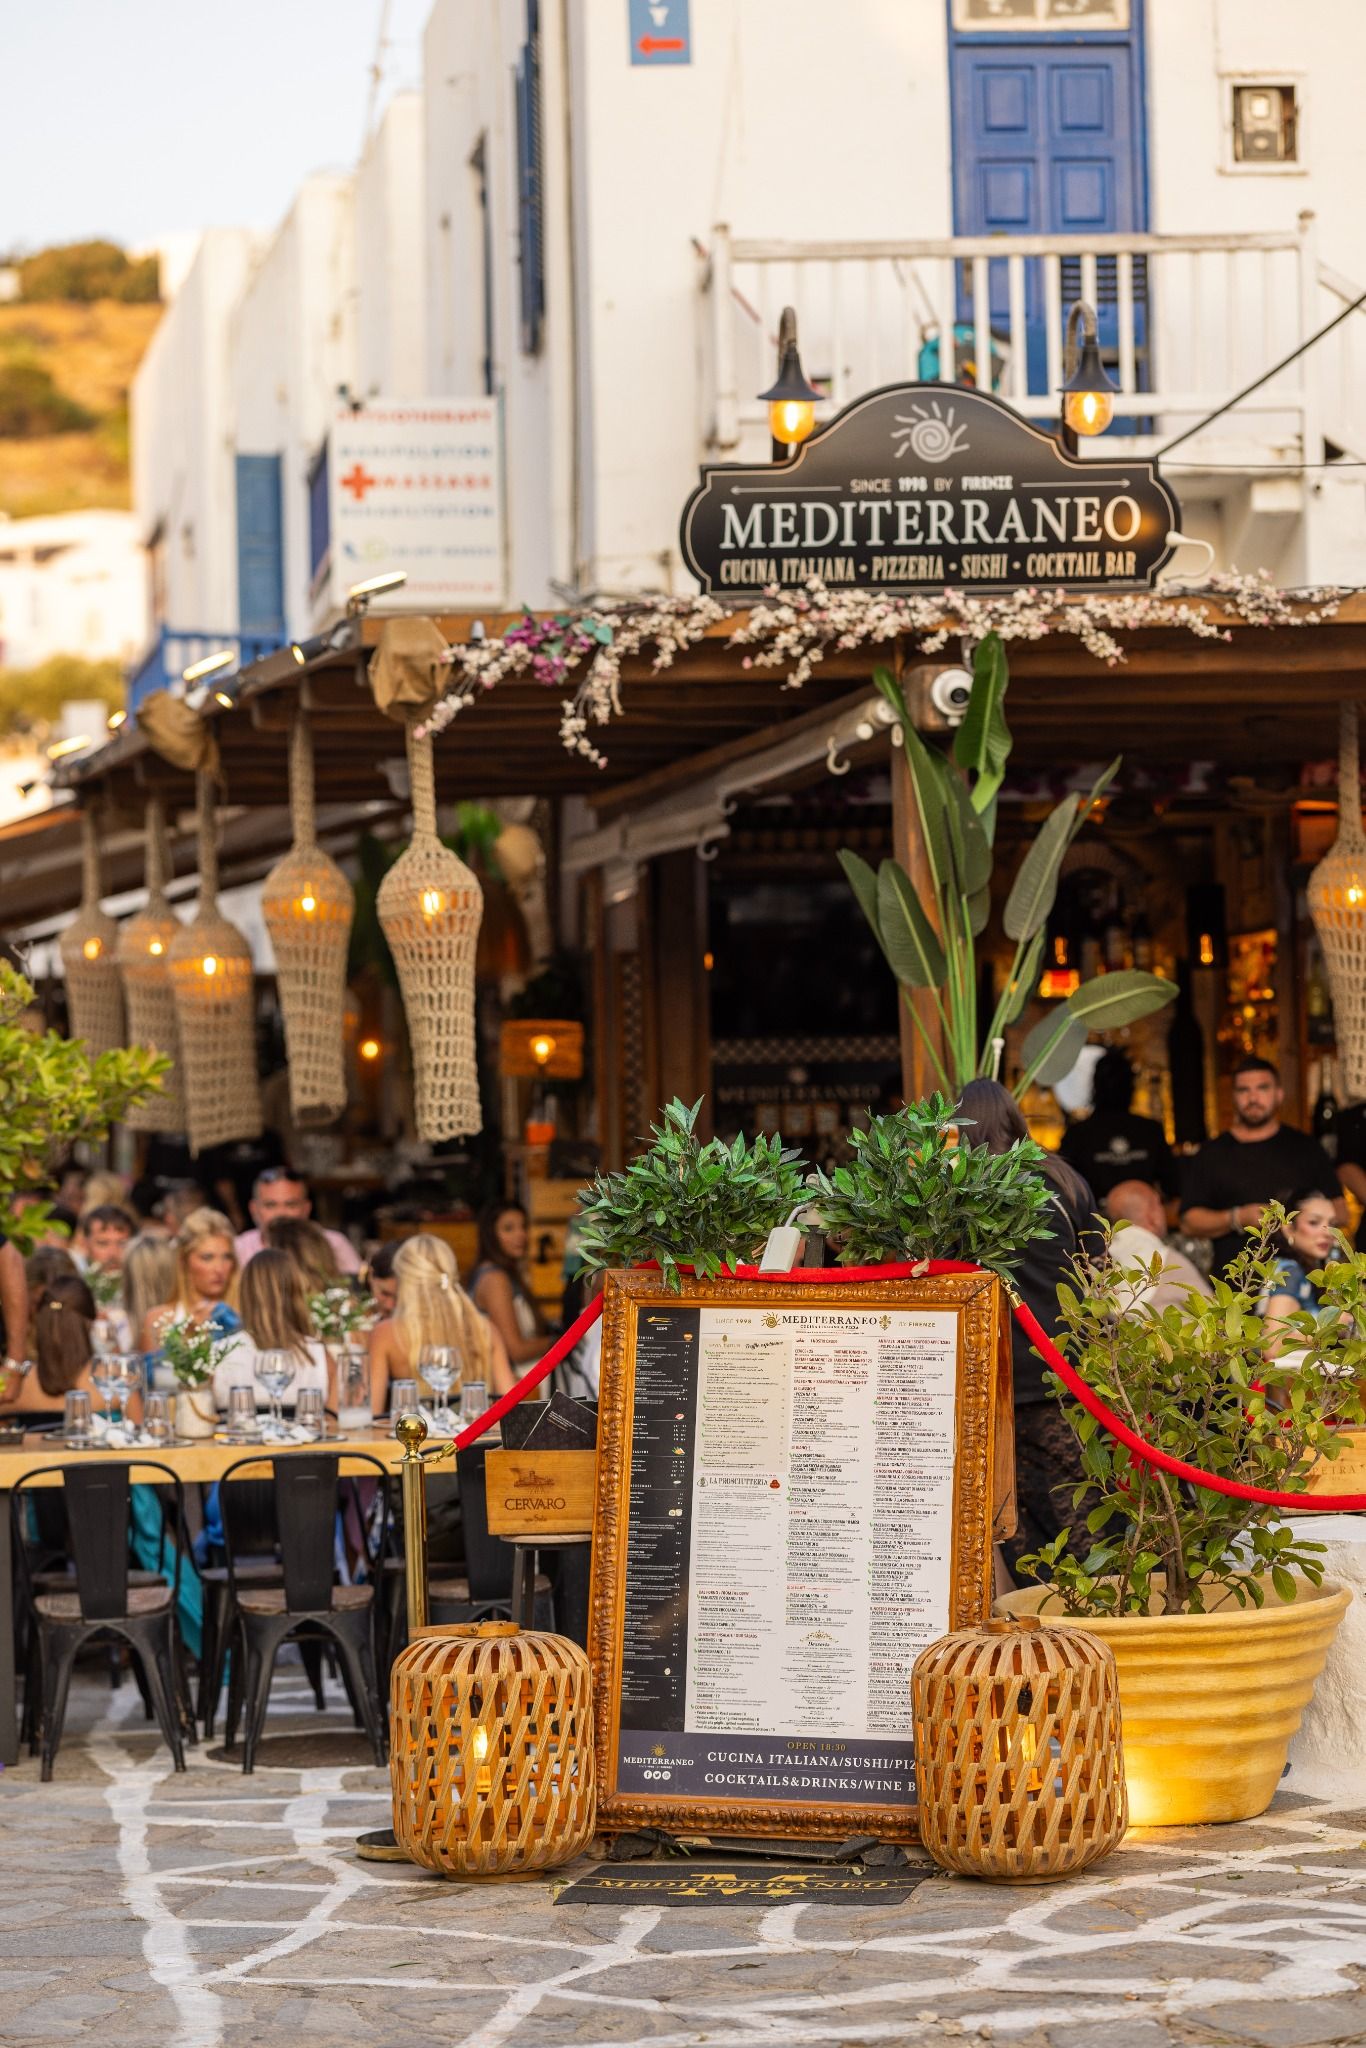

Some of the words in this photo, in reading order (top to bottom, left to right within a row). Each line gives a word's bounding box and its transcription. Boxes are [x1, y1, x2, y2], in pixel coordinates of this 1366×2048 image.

[850, 478, 892, 493] SINCE
[934, 477, 953, 492] BY
[720, 495, 1141, 549] MEDITERRANEO
[720, 558, 778, 584] CUCINA
[782, 556, 856, 583] ITALIANA
[871, 555, 944, 581] PIZZERIA
[961, 553, 1008, 578] SUSHI
[1026, 552, 1101, 578] COCKTAIL
[1105, 551, 1136, 576] BAR
[782, 1316, 877, 1325] MEDITERRANEO
[504, 1498, 566, 1510] CERVARO
[787, 1742, 816, 1750] OPEN
[624, 1756, 694, 1766] MEDITERRANEO
[707, 1751, 764, 1764] CUCINA
[704, 1773, 902, 1791] COCKTAILS&DRINKS/WINE
[598, 1880, 888, 1888] MEDITERRANEO
